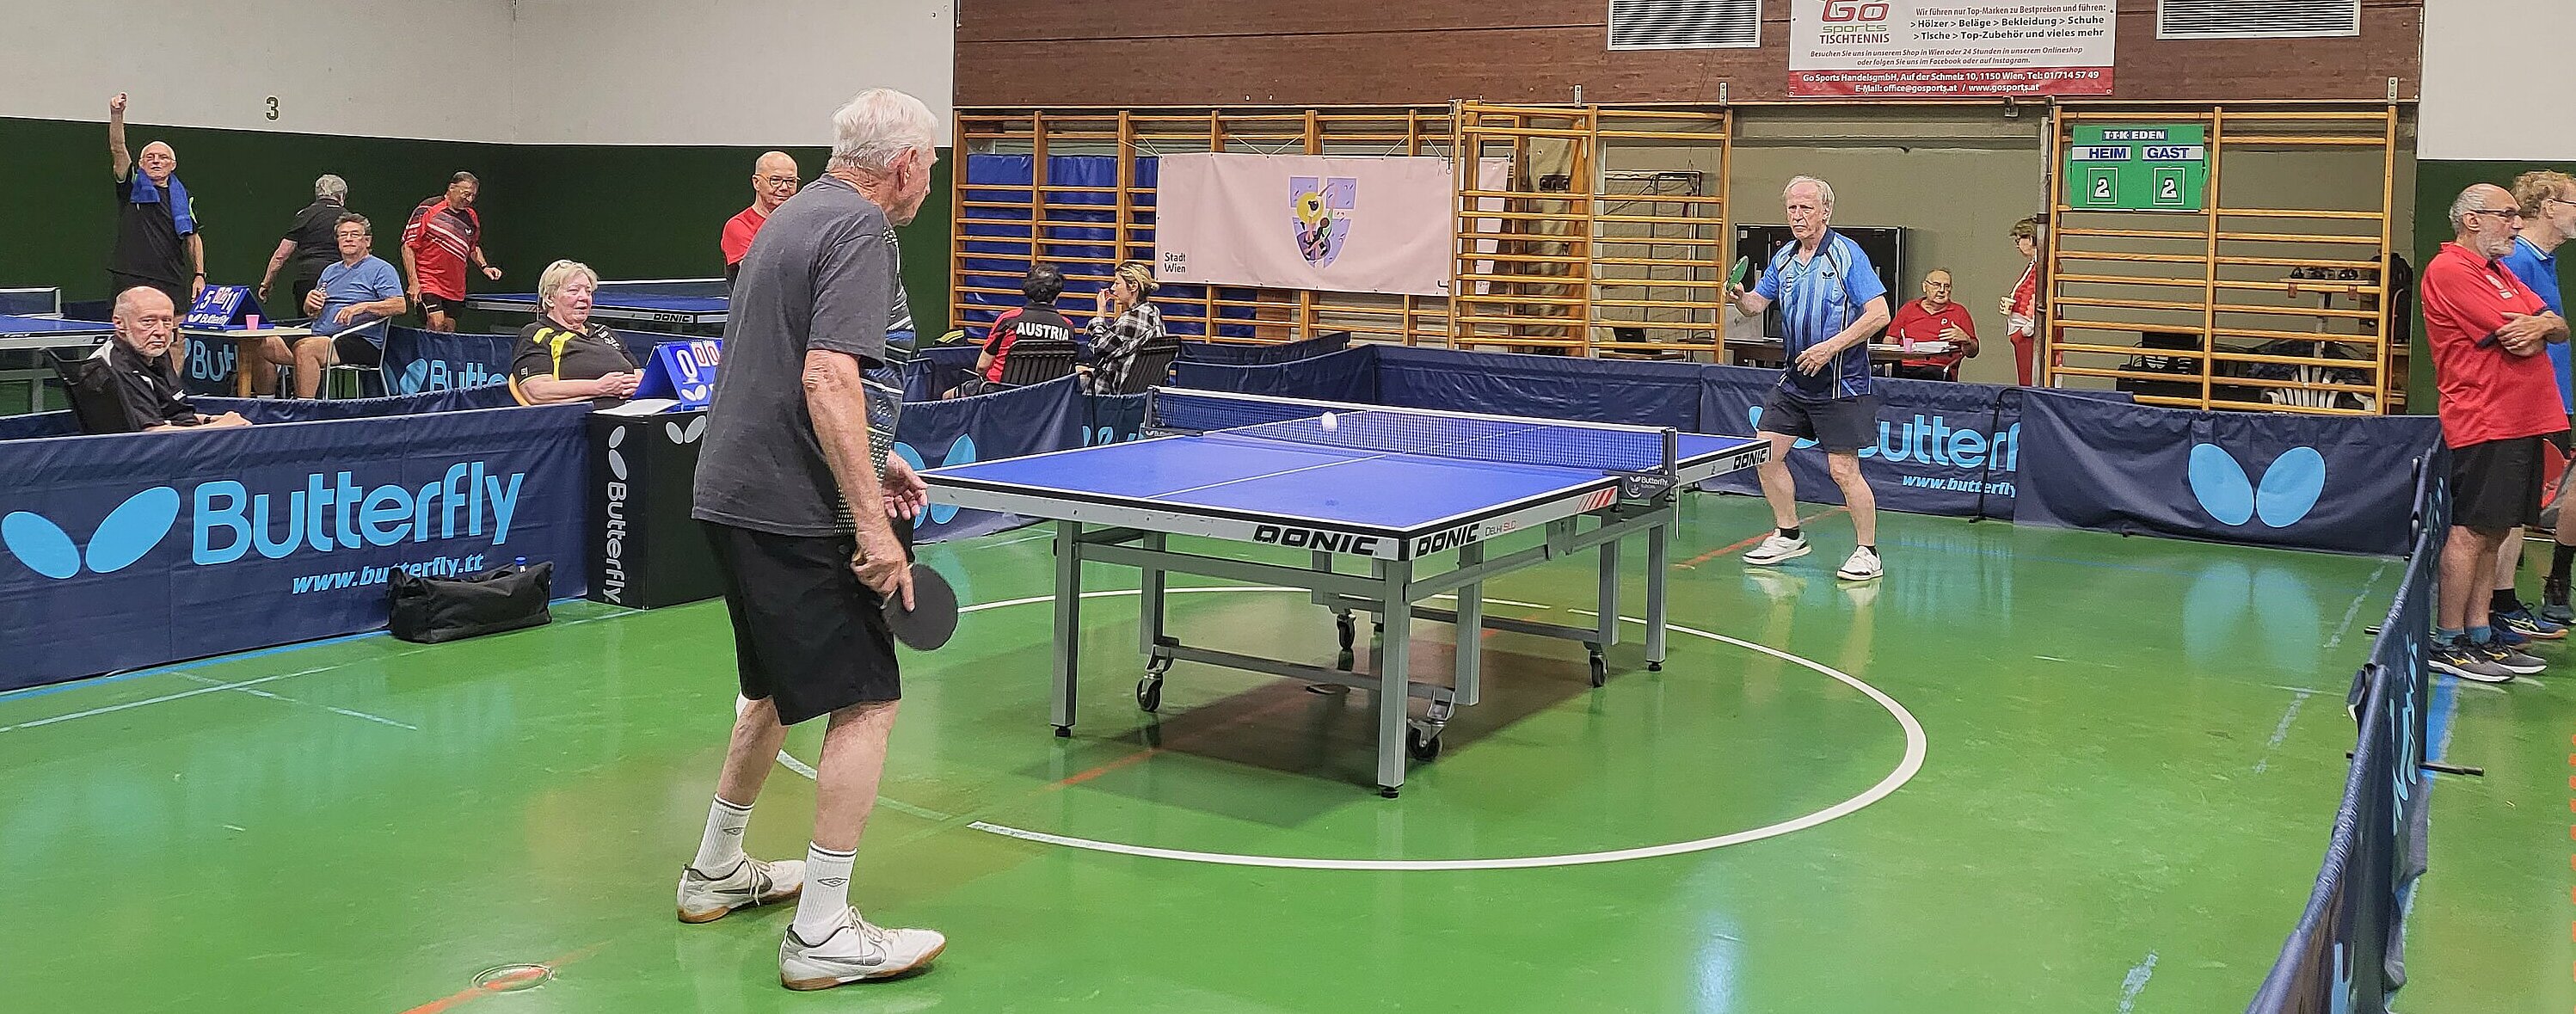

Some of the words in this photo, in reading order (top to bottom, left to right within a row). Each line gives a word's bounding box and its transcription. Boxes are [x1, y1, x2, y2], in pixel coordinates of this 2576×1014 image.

[1822, 0, 1890, 22] Go
[1967, 7, 2008, 16] Top-Marken
[2020, 5, 2062, 15] Bestpreisen
[2079, 3, 2106, 12] führen:
[1959, 18, 1991, 28] Beläge
[2001, 17, 2056, 27] Bekleidung
[2068, 15, 2105, 24] Schuhe
[1823, 23, 1887, 34] sports
[1921, 31, 1951, 40] Tische
[1961, 29, 2023, 40] Top-Zubehör
[2047, 28, 2075, 37] vieles
[2078, 28, 2104, 36] mehr
[1819, 34, 1890, 44] TISCHTENNIS
[1815, 74, 1840, 83] Sports
[1841, 73, 1899, 83] HandelsgmbH,
[1931, 72, 1964, 81] Schmelz
[1965, 72, 1978, 82] 10,
[2002, 71, 2026, 80] Wien,
[2044, 71, 2074, 79] 01/714
[1883, 83, 1958, 93] office@gosports.at
[1969, 83, 2039, 93] www.gosports.at
[266, 96, 280, 121] 3
[2132, 131, 2165, 139] EDEN
[2088, 148, 2126, 159] HEIM
[2147, 147, 2190, 159] GAST
[2093, 178, 2111, 198] 2
[2160, 179, 2178, 199] 2
[1165, 252, 1185, 262] Stadt
[1165, 263, 1185, 273] Wien
[654, 314, 691, 323] DONIC
[1016, 322, 1069, 341] AUSTRIA
[677, 349, 698, 378] 0
[1858, 415, 2020, 472] utterf
[1733, 448, 1768, 470] DONIC
[1641, 476, 1669, 487] Butterfly
[192, 461, 526, 566] Butterfly
[603, 482, 627, 604] Butterfly
[1253, 525, 1379, 556] DONIC
[1415, 523, 1480, 557] DONIC
